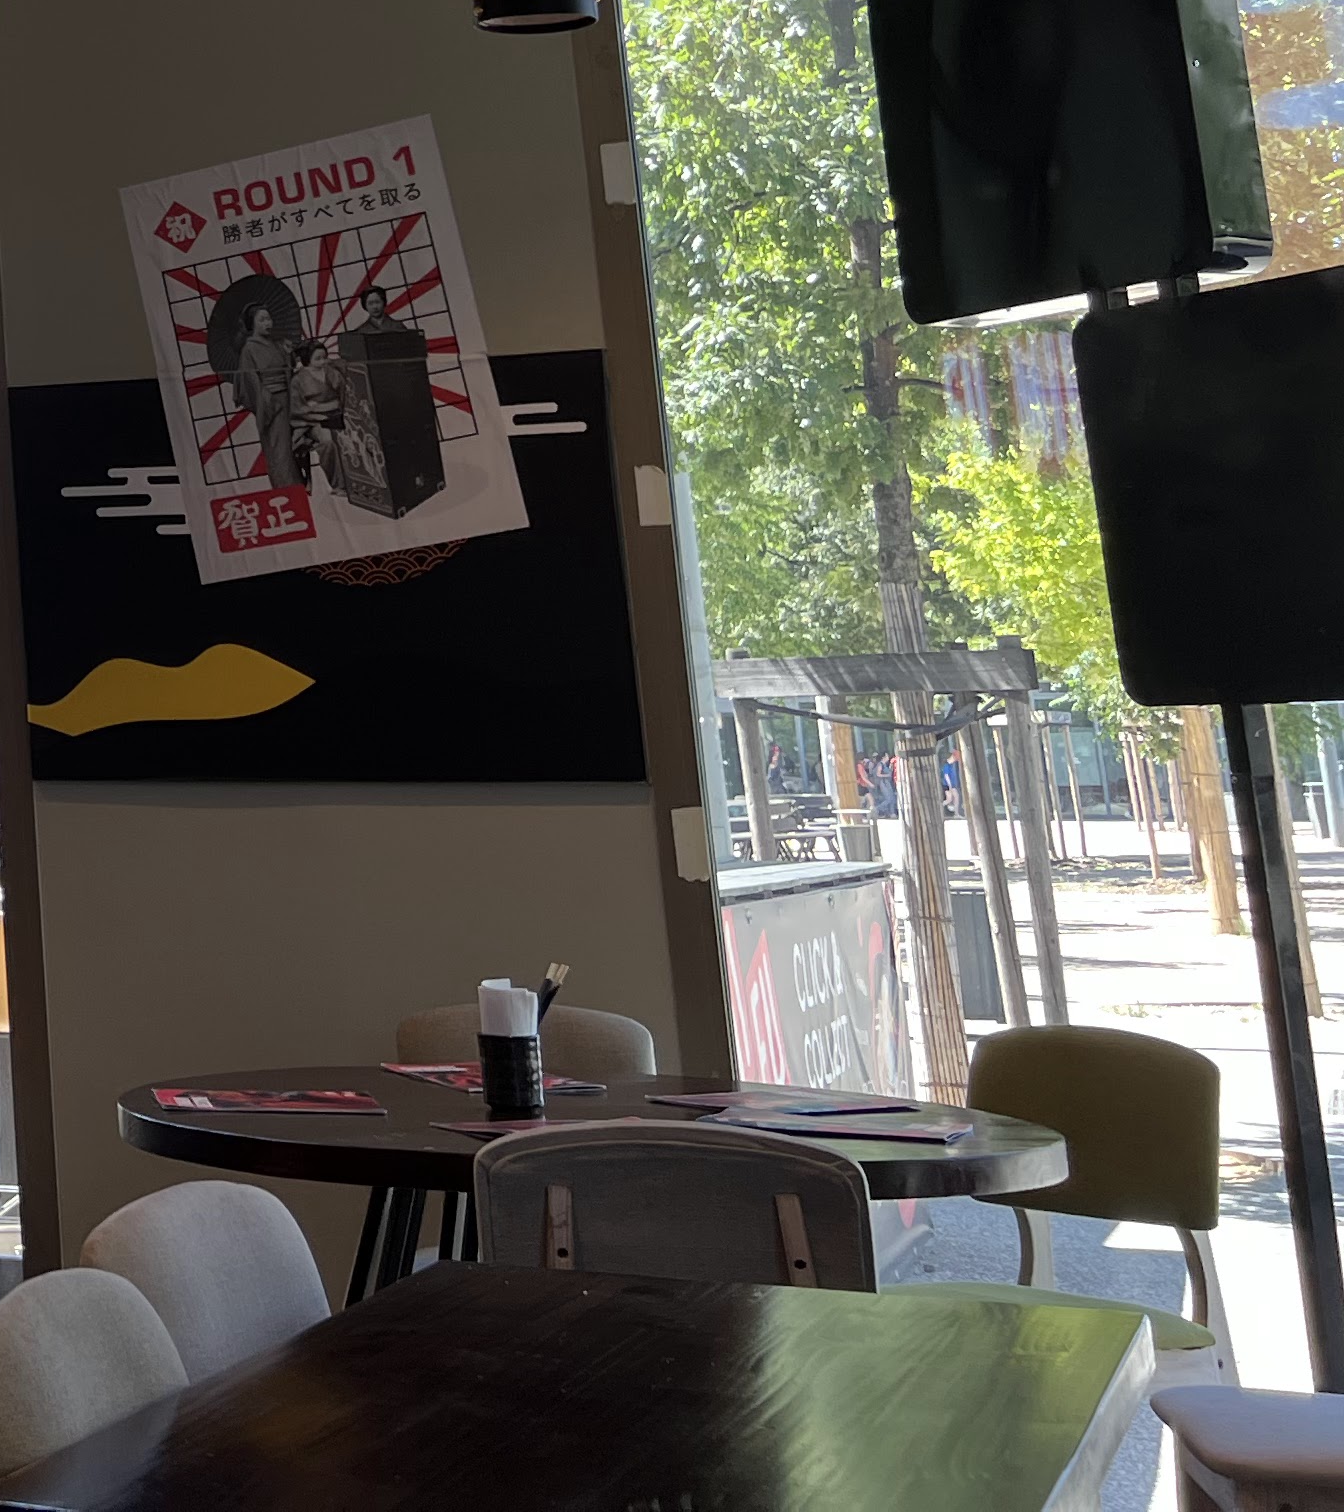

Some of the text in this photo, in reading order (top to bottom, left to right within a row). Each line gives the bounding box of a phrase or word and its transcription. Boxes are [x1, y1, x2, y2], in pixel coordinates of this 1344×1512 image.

[213, 145, 417, 220] ROUND 1
[222, 183, 422, 245] 勝者がすべてを取る
[164, 211, 197, 244] 祝
[793, 936, 836, 1013] CLICK
